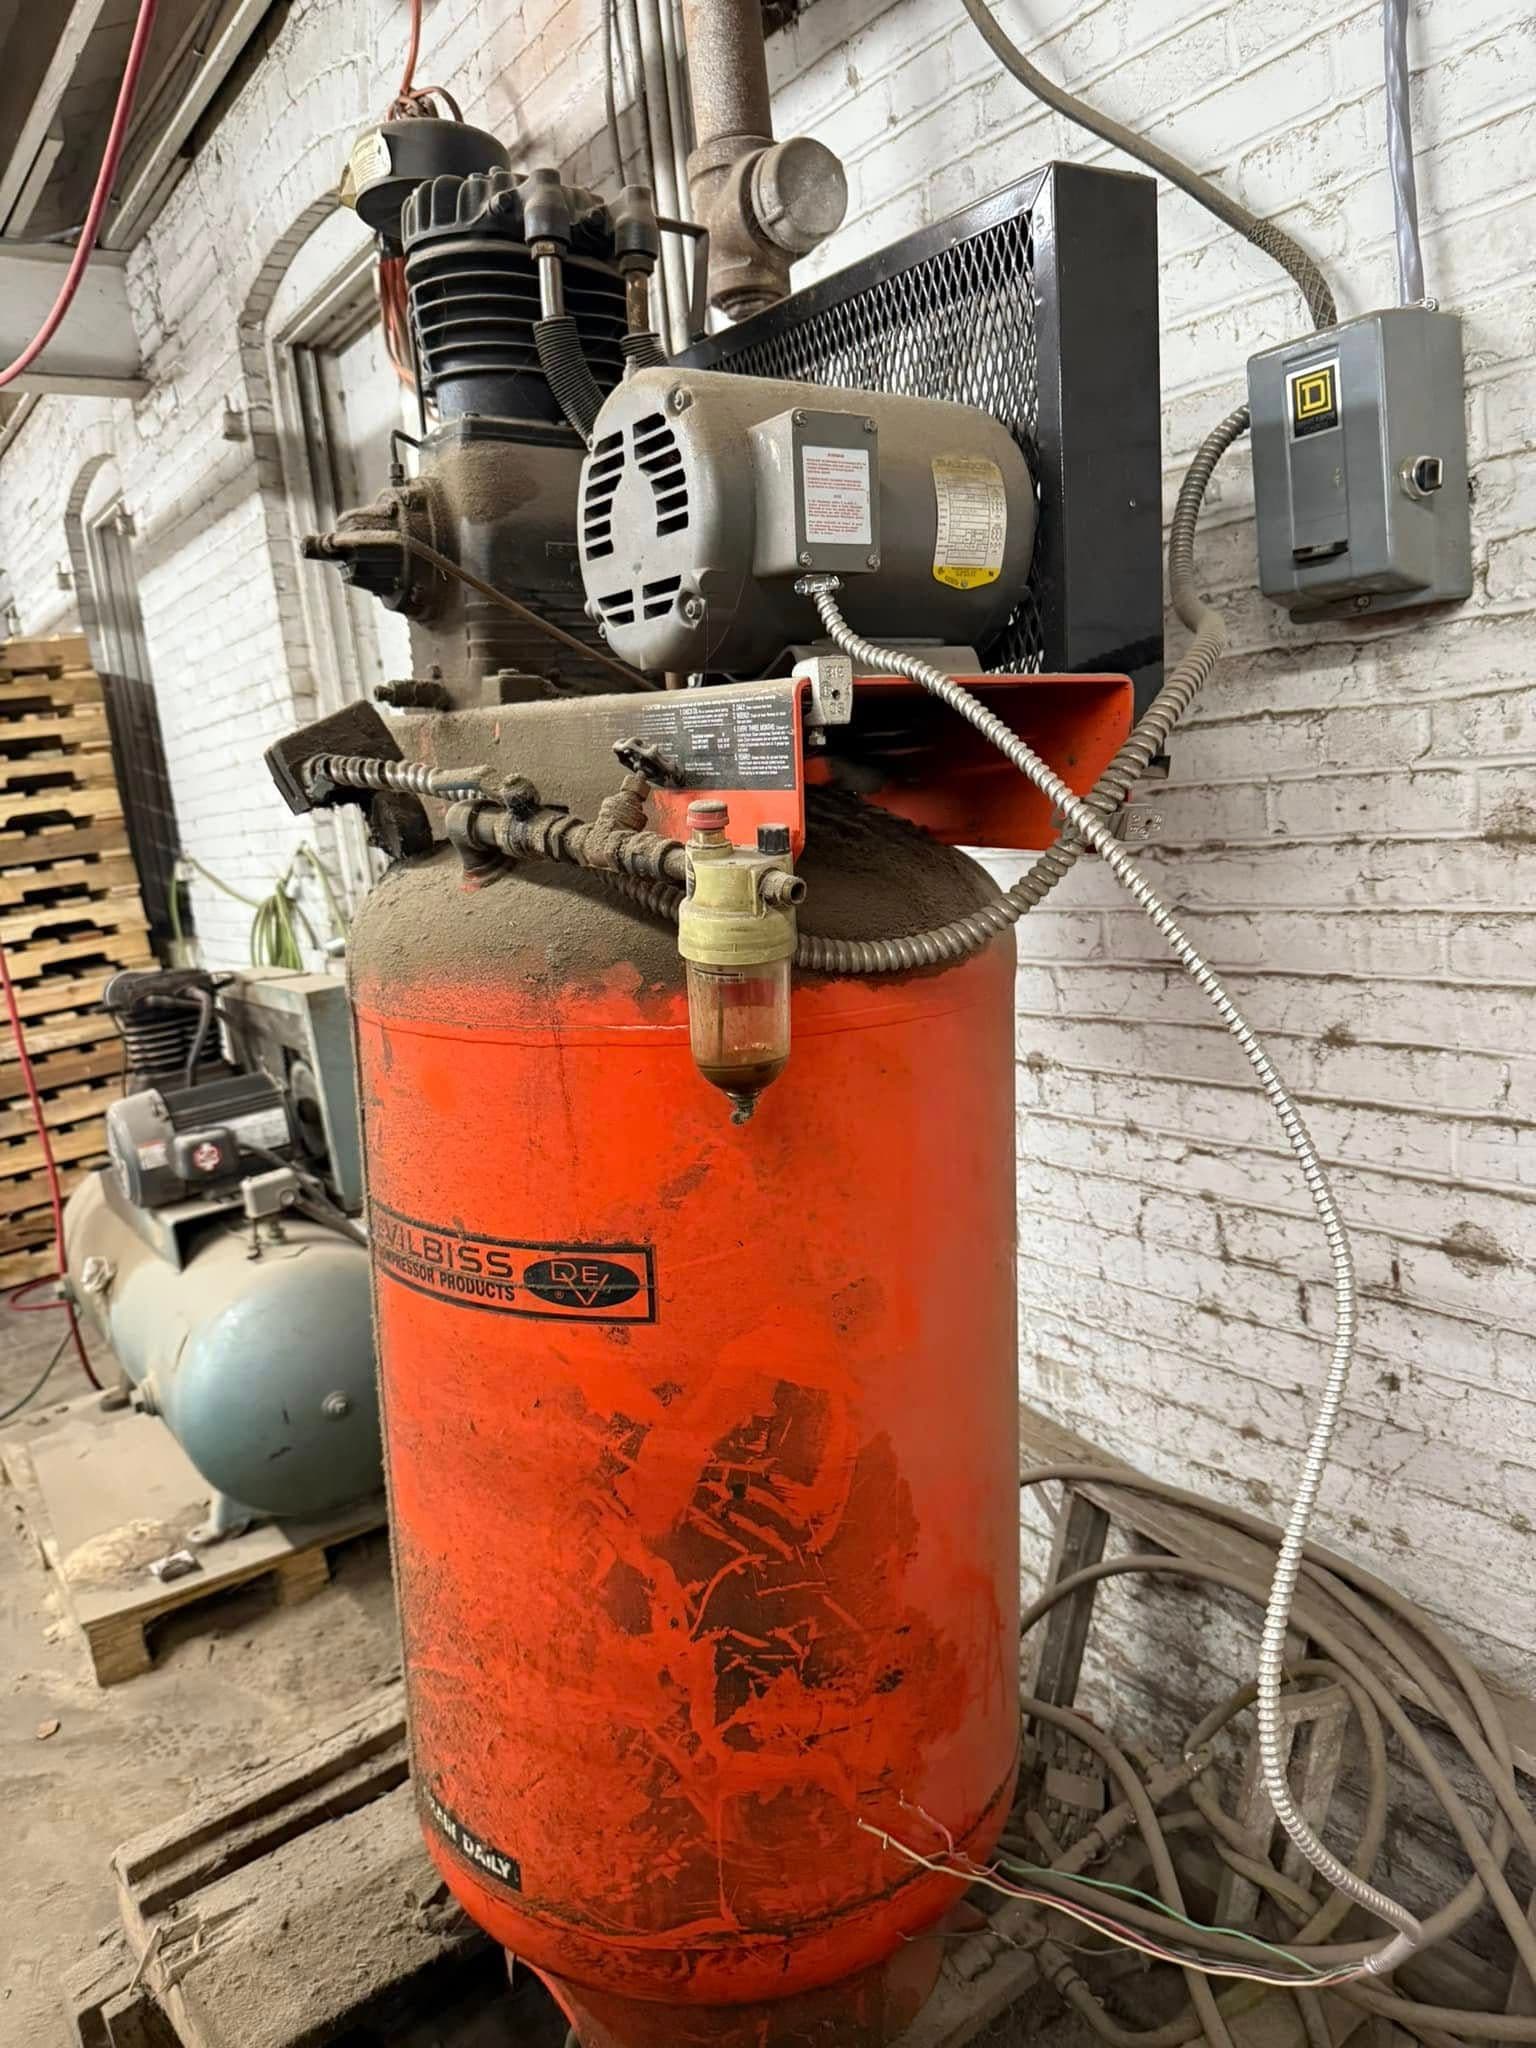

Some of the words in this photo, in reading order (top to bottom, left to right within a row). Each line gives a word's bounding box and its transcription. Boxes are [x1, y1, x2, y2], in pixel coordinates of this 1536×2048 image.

[1302, 379, 1326, 411] D
[377, 1219, 514, 1279] VILBISS
[439, 1270, 516, 1302] PRODUCTS
[462, 1833, 511, 1879] DAILY
